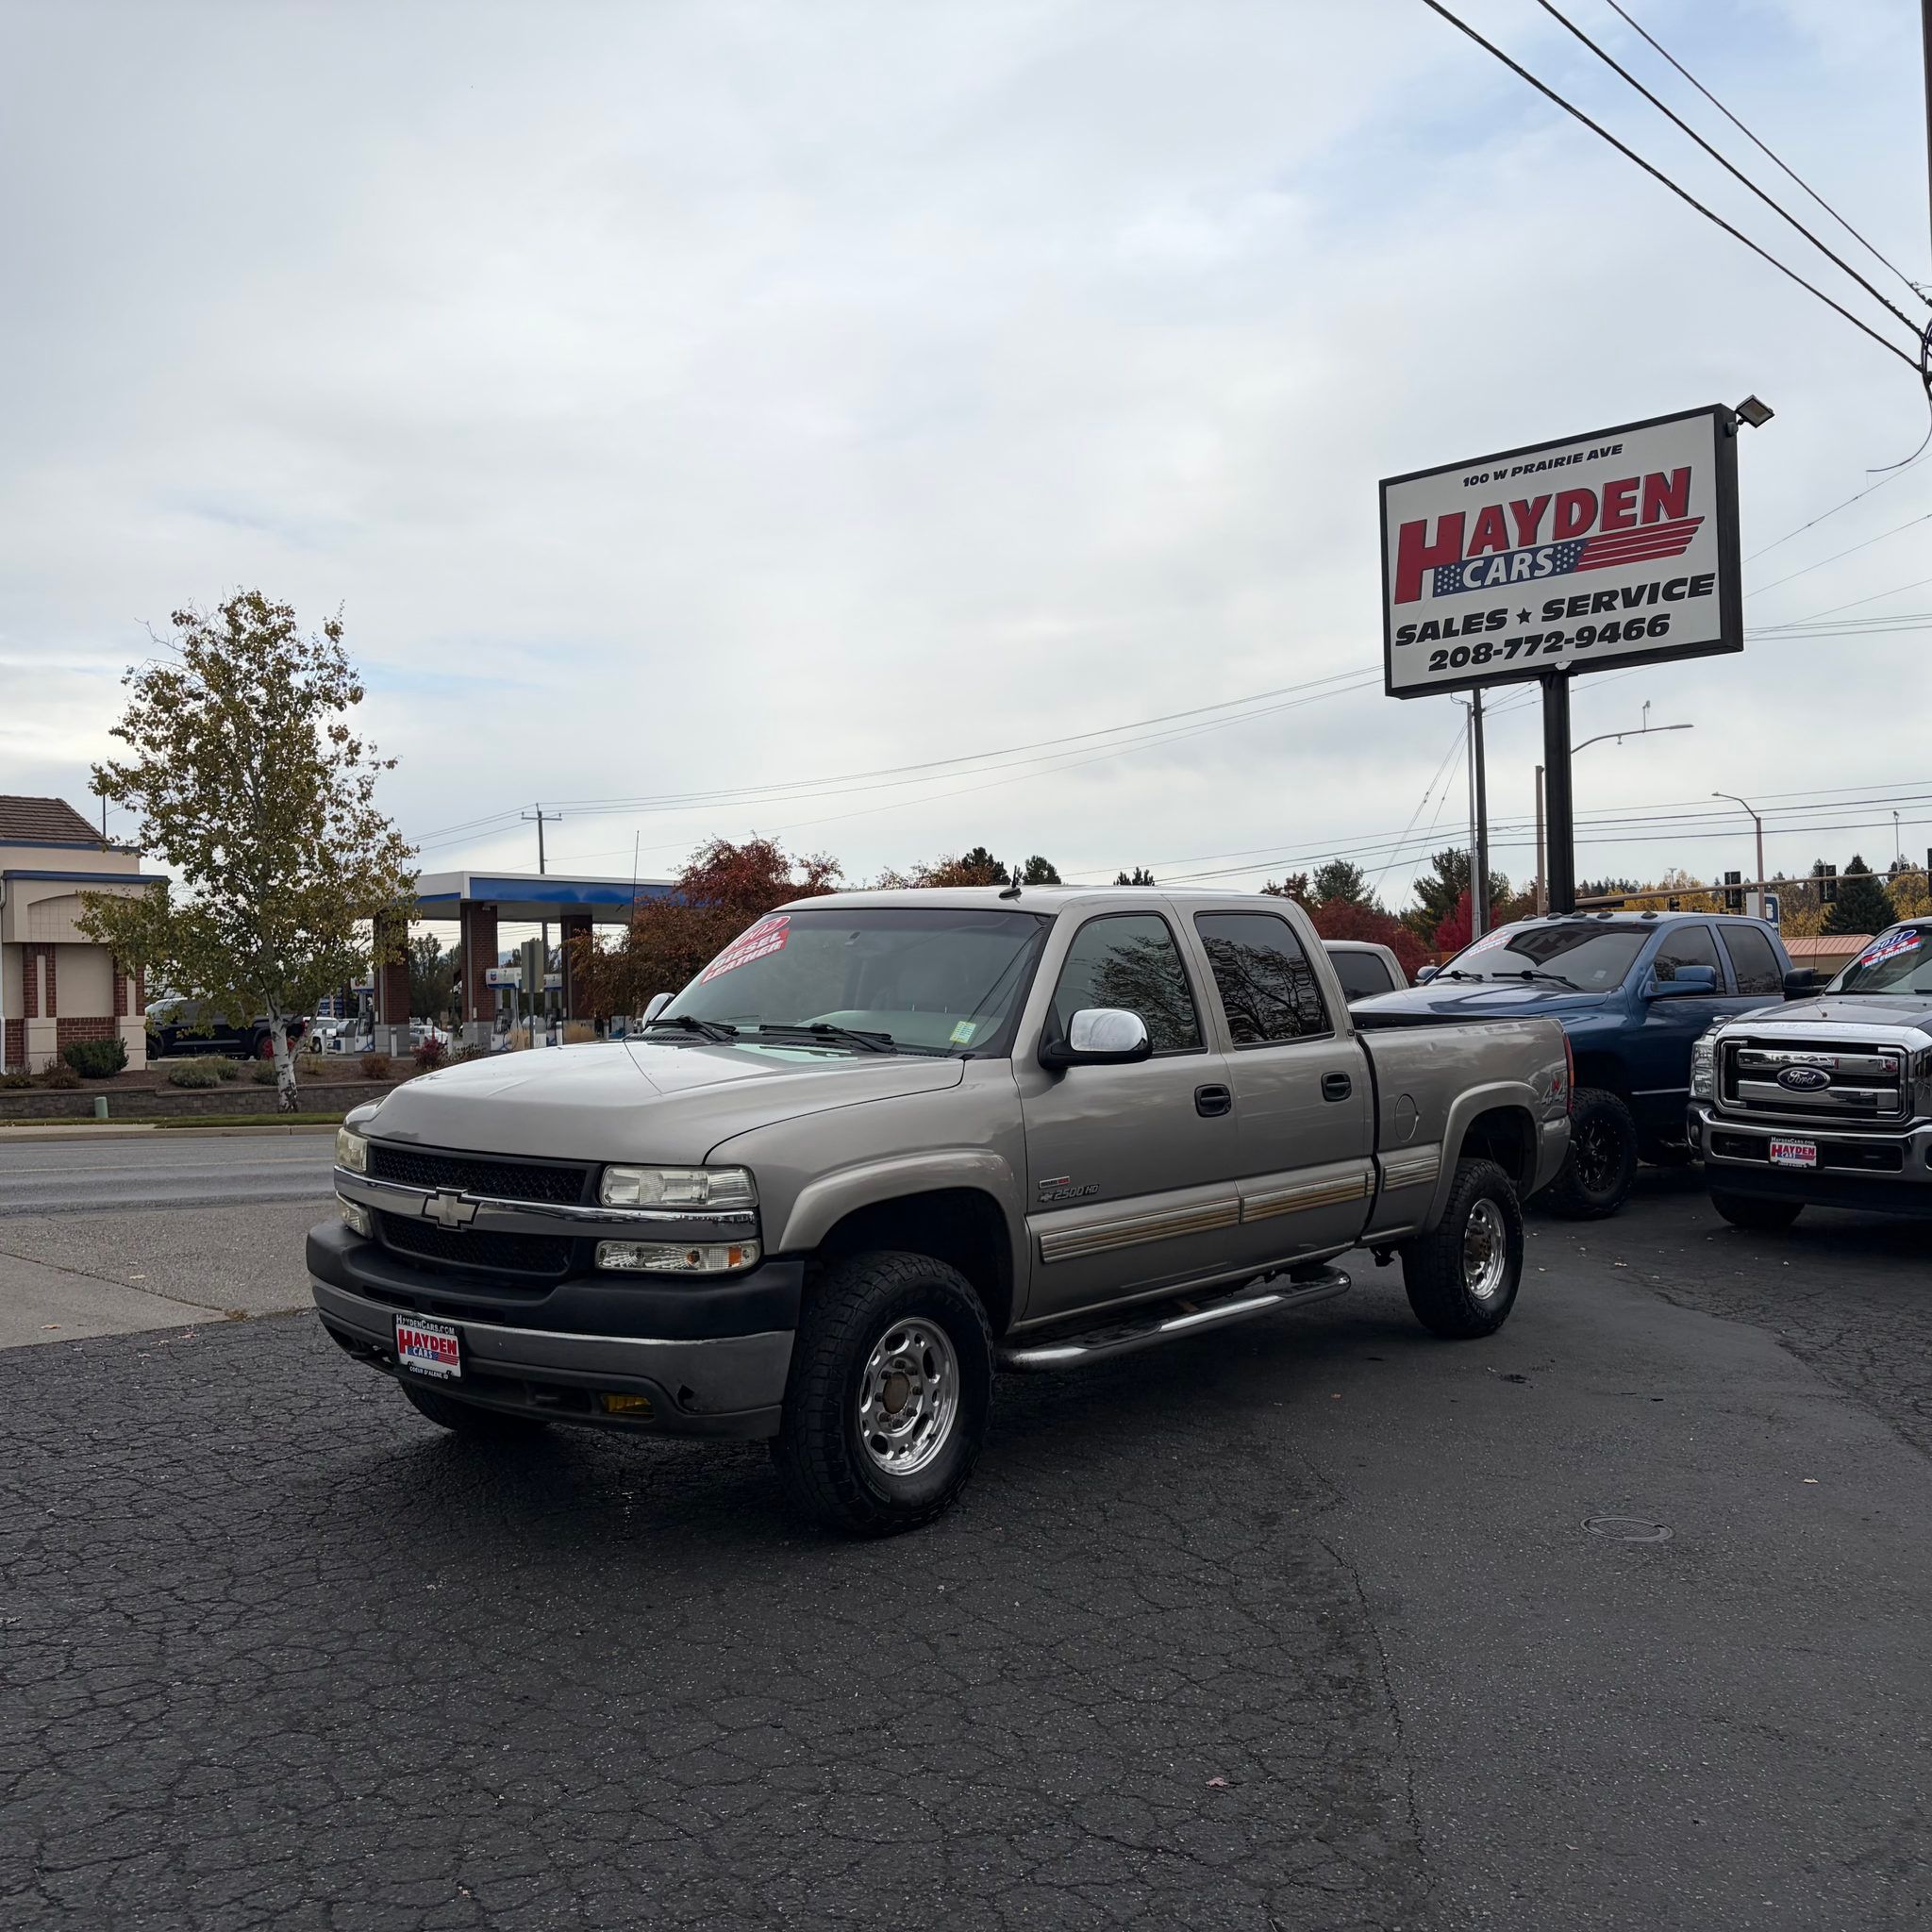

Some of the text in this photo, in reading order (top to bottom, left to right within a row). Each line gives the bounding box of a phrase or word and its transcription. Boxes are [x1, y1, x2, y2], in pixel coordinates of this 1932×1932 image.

[1462, 443, 1624, 487] 100 W PRAIRIE AVE
[1394, 466, 1692, 605] HAYDEN
[1461, 547, 1556, 589] CARS
[1395, 573, 1716, 646] SALES SERVICE
[1428, 613, 1671, 672] 208-772-9466
[702, 940, 784, 983] LEATHER
[711, 932, 781, 971] DIESEL
[1879, 942, 1920, 961] FINANCE
[1787, 1070, 1816, 1085] Ford
[1771, 1143, 1815, 1158] HAYDEN
[1054, 1184, 1099, 1201] 2500 HD
[398, 1328, 458, 1356] HAYDEN
[412, 1347, 433, 1359] CARS
